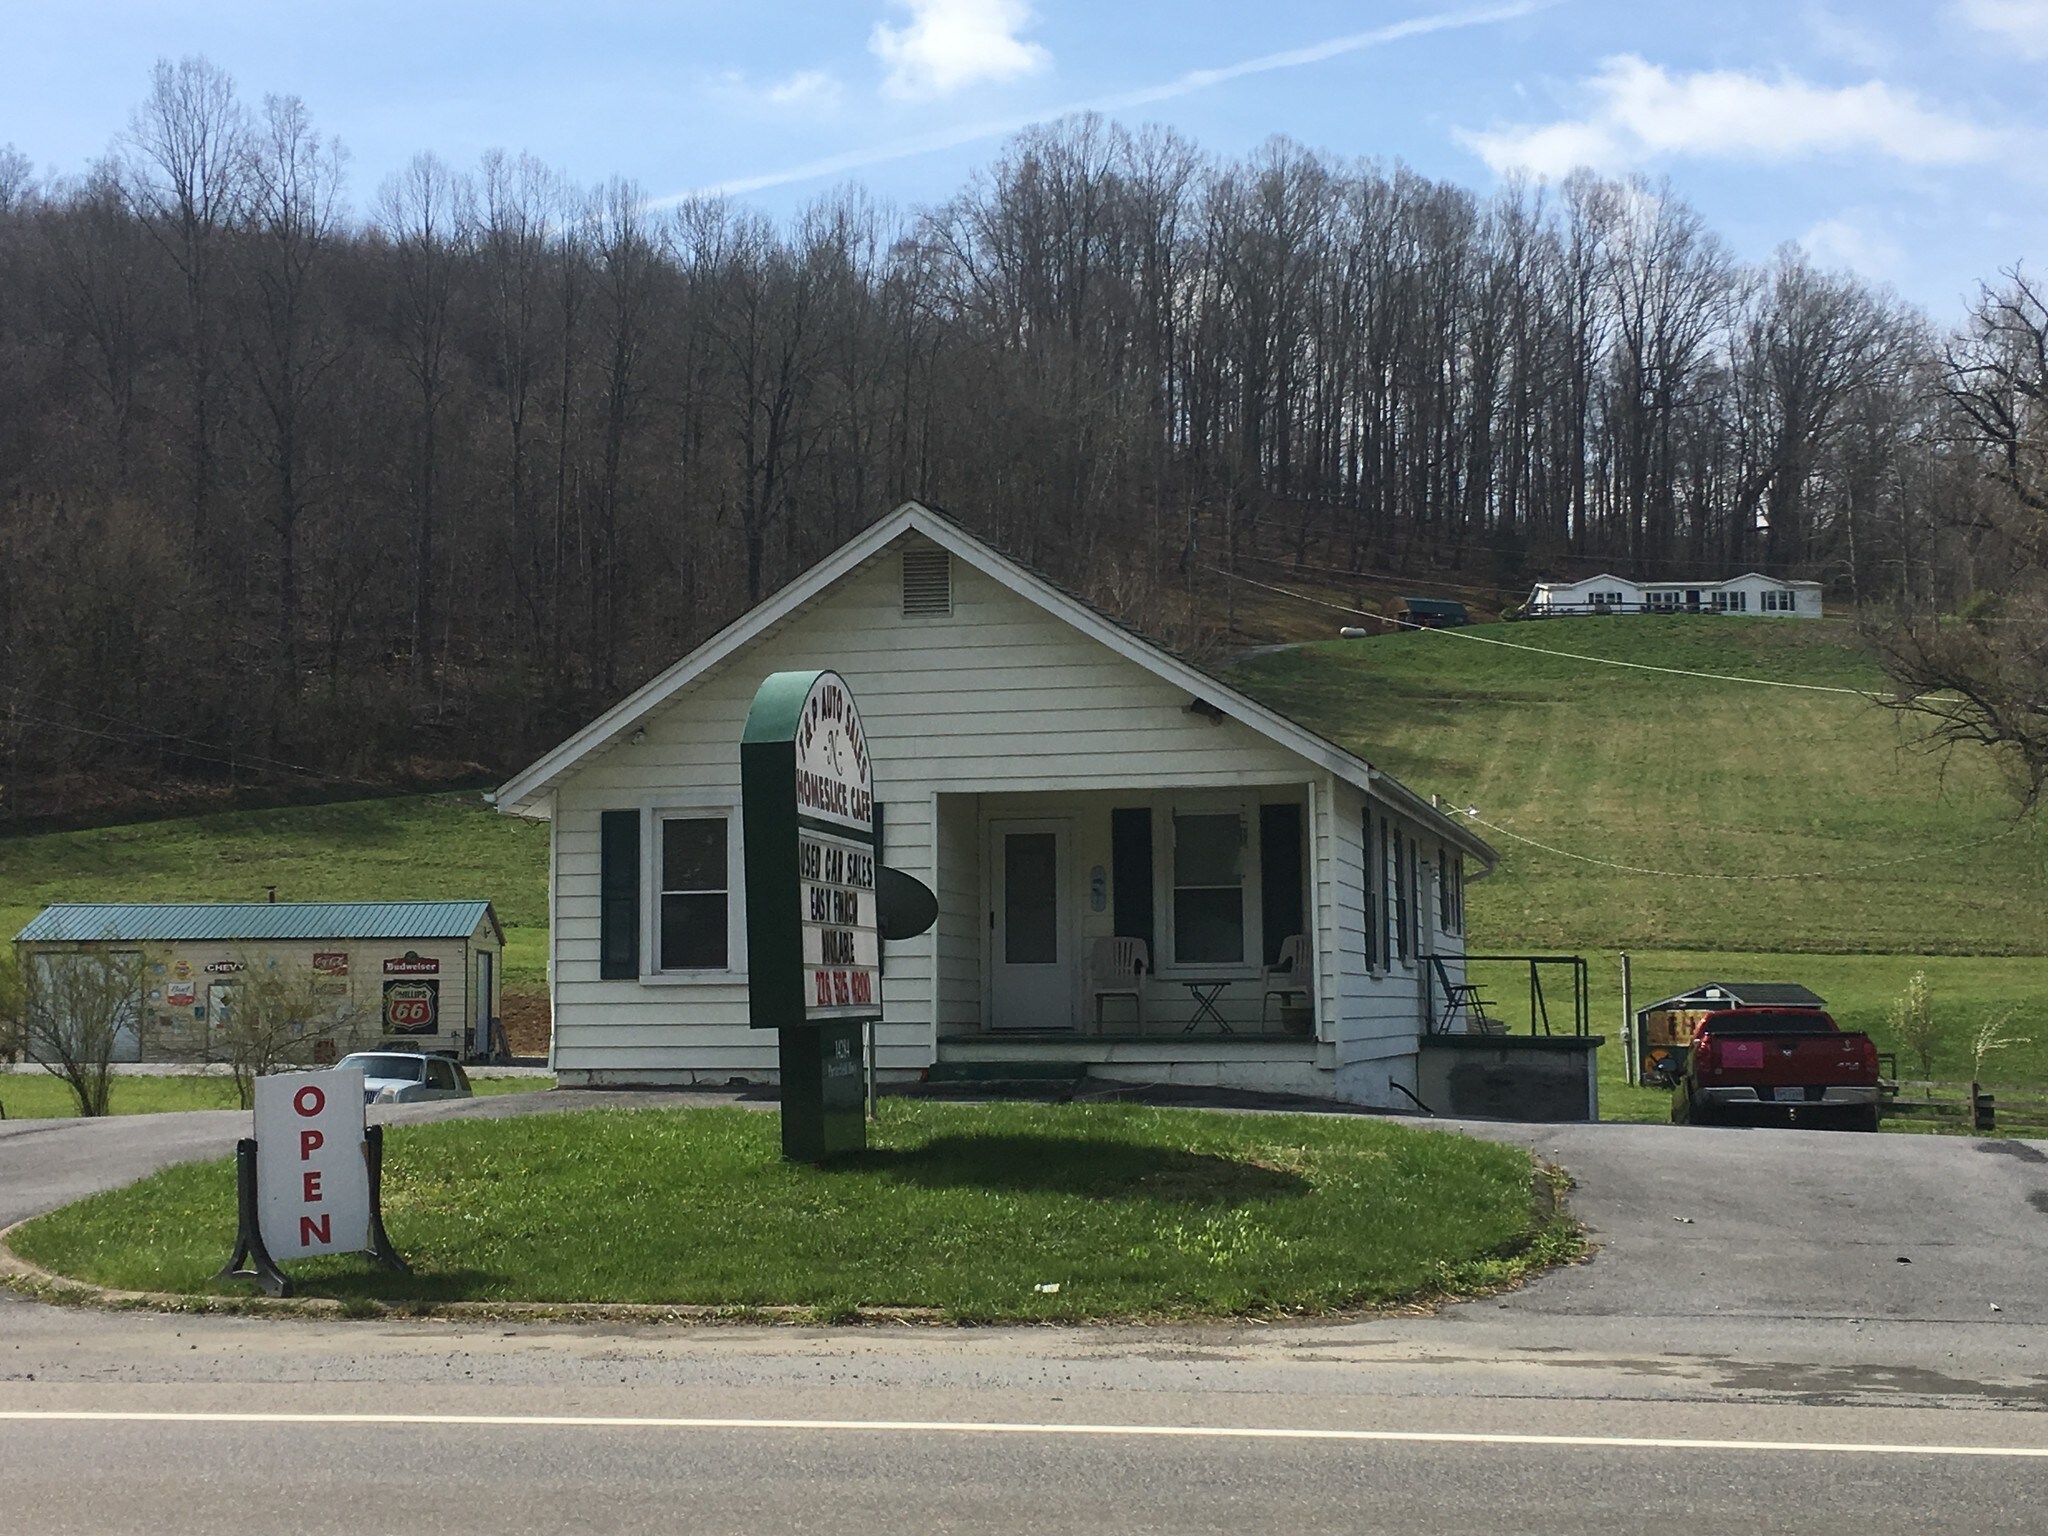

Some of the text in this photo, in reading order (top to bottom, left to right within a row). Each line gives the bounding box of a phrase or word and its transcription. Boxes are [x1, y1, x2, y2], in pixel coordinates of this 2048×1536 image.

[811, 696, 818, 731] P
[821, 685, 843, 723] AUTO
[845, 704, 867, 785] SALES
[797, 768, 871, 823] HOMESLICE CAFE
[800, 842, 873, 887] USED CAR SALES
[811, 887, 832, 922] EASY
[207, 963, 244, 971] CHEVY
[386, 962, 437, 971] Budweiser
[395, 990, 427, 999] PHILLIPS
[396, 1003, 424, 1018] 66
[293, 1085, 332, 1247] OPEN
